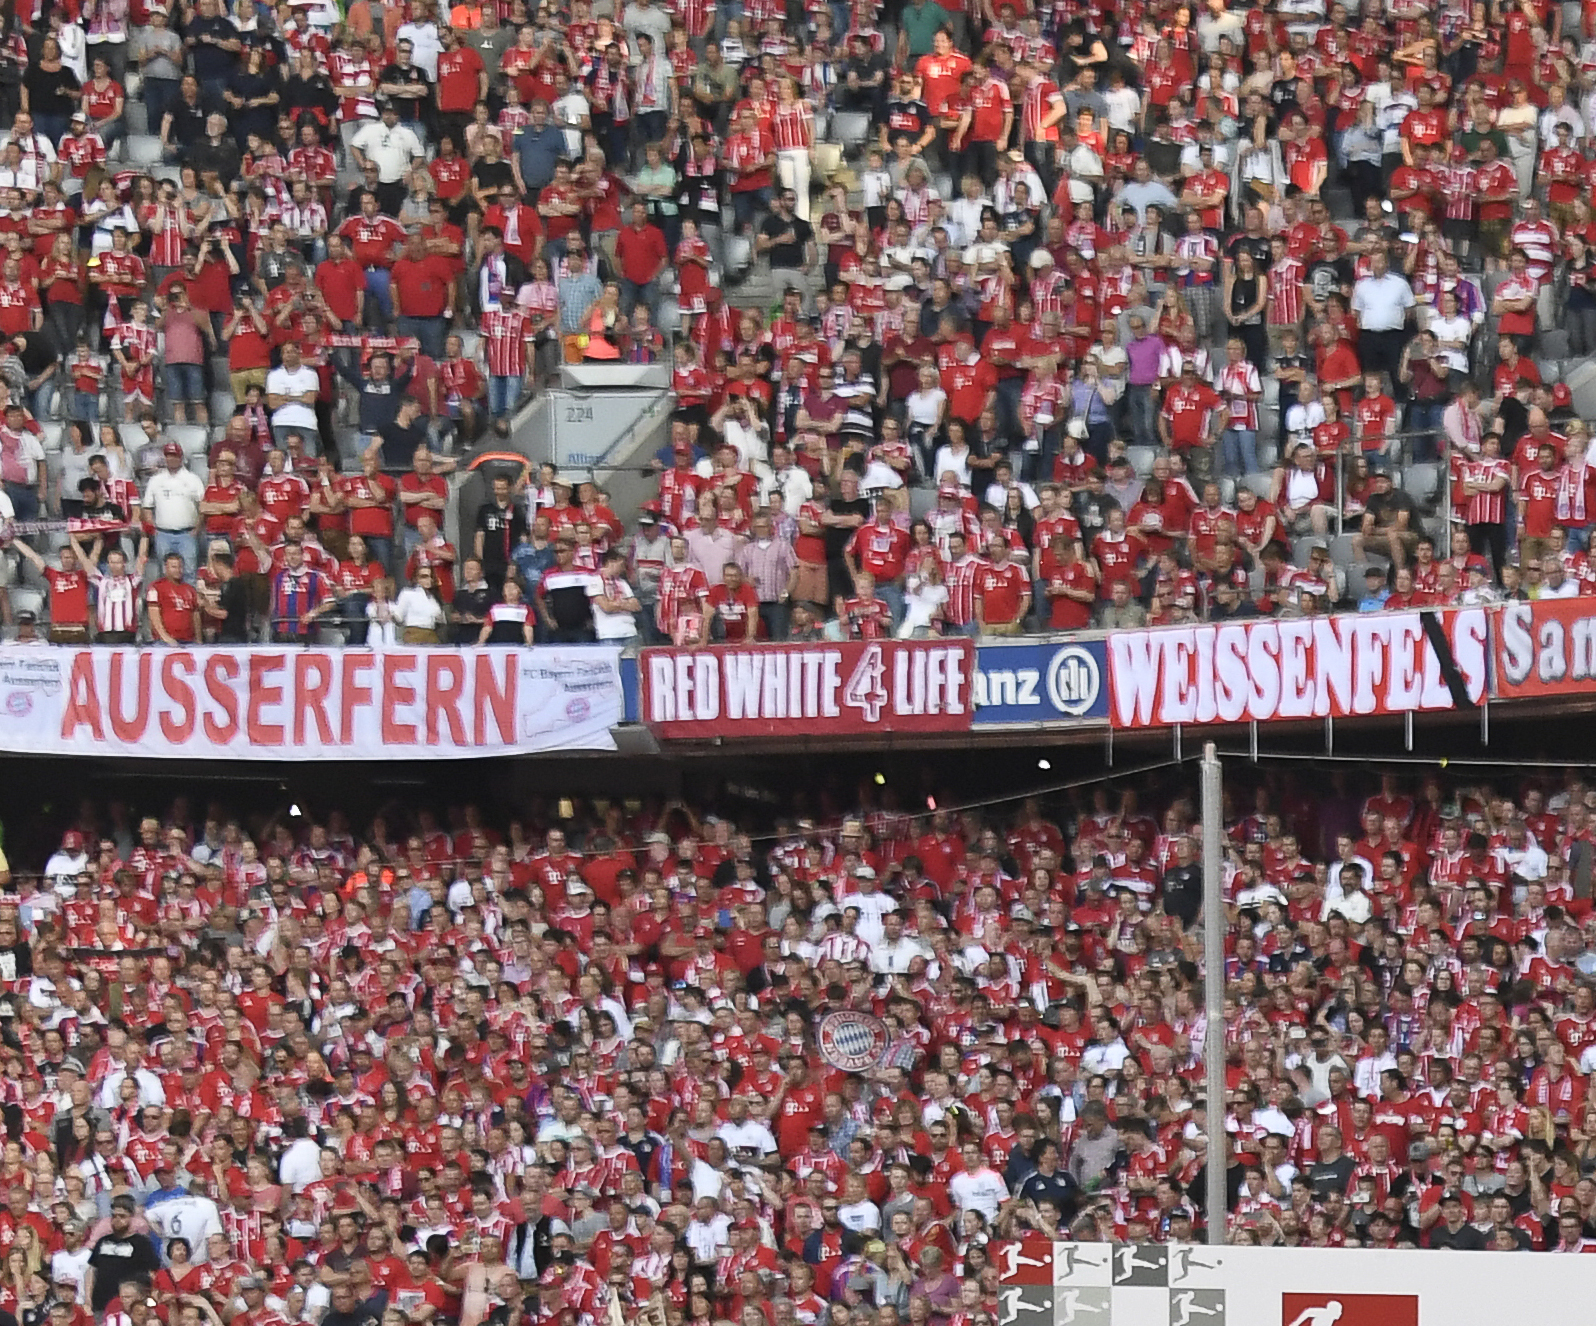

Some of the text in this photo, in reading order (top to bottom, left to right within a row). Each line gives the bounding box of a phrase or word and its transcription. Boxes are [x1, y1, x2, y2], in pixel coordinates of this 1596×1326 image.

[566, 406, 594, 423] 224
[61, 651, 518, 746] AUSSERFERN
[649, 641, 966, 723] RED WHITE 4 LIFE
[1108, 608, 1487, 728] WEISSENFELS
[170, 1211, 183, 1235] 6
